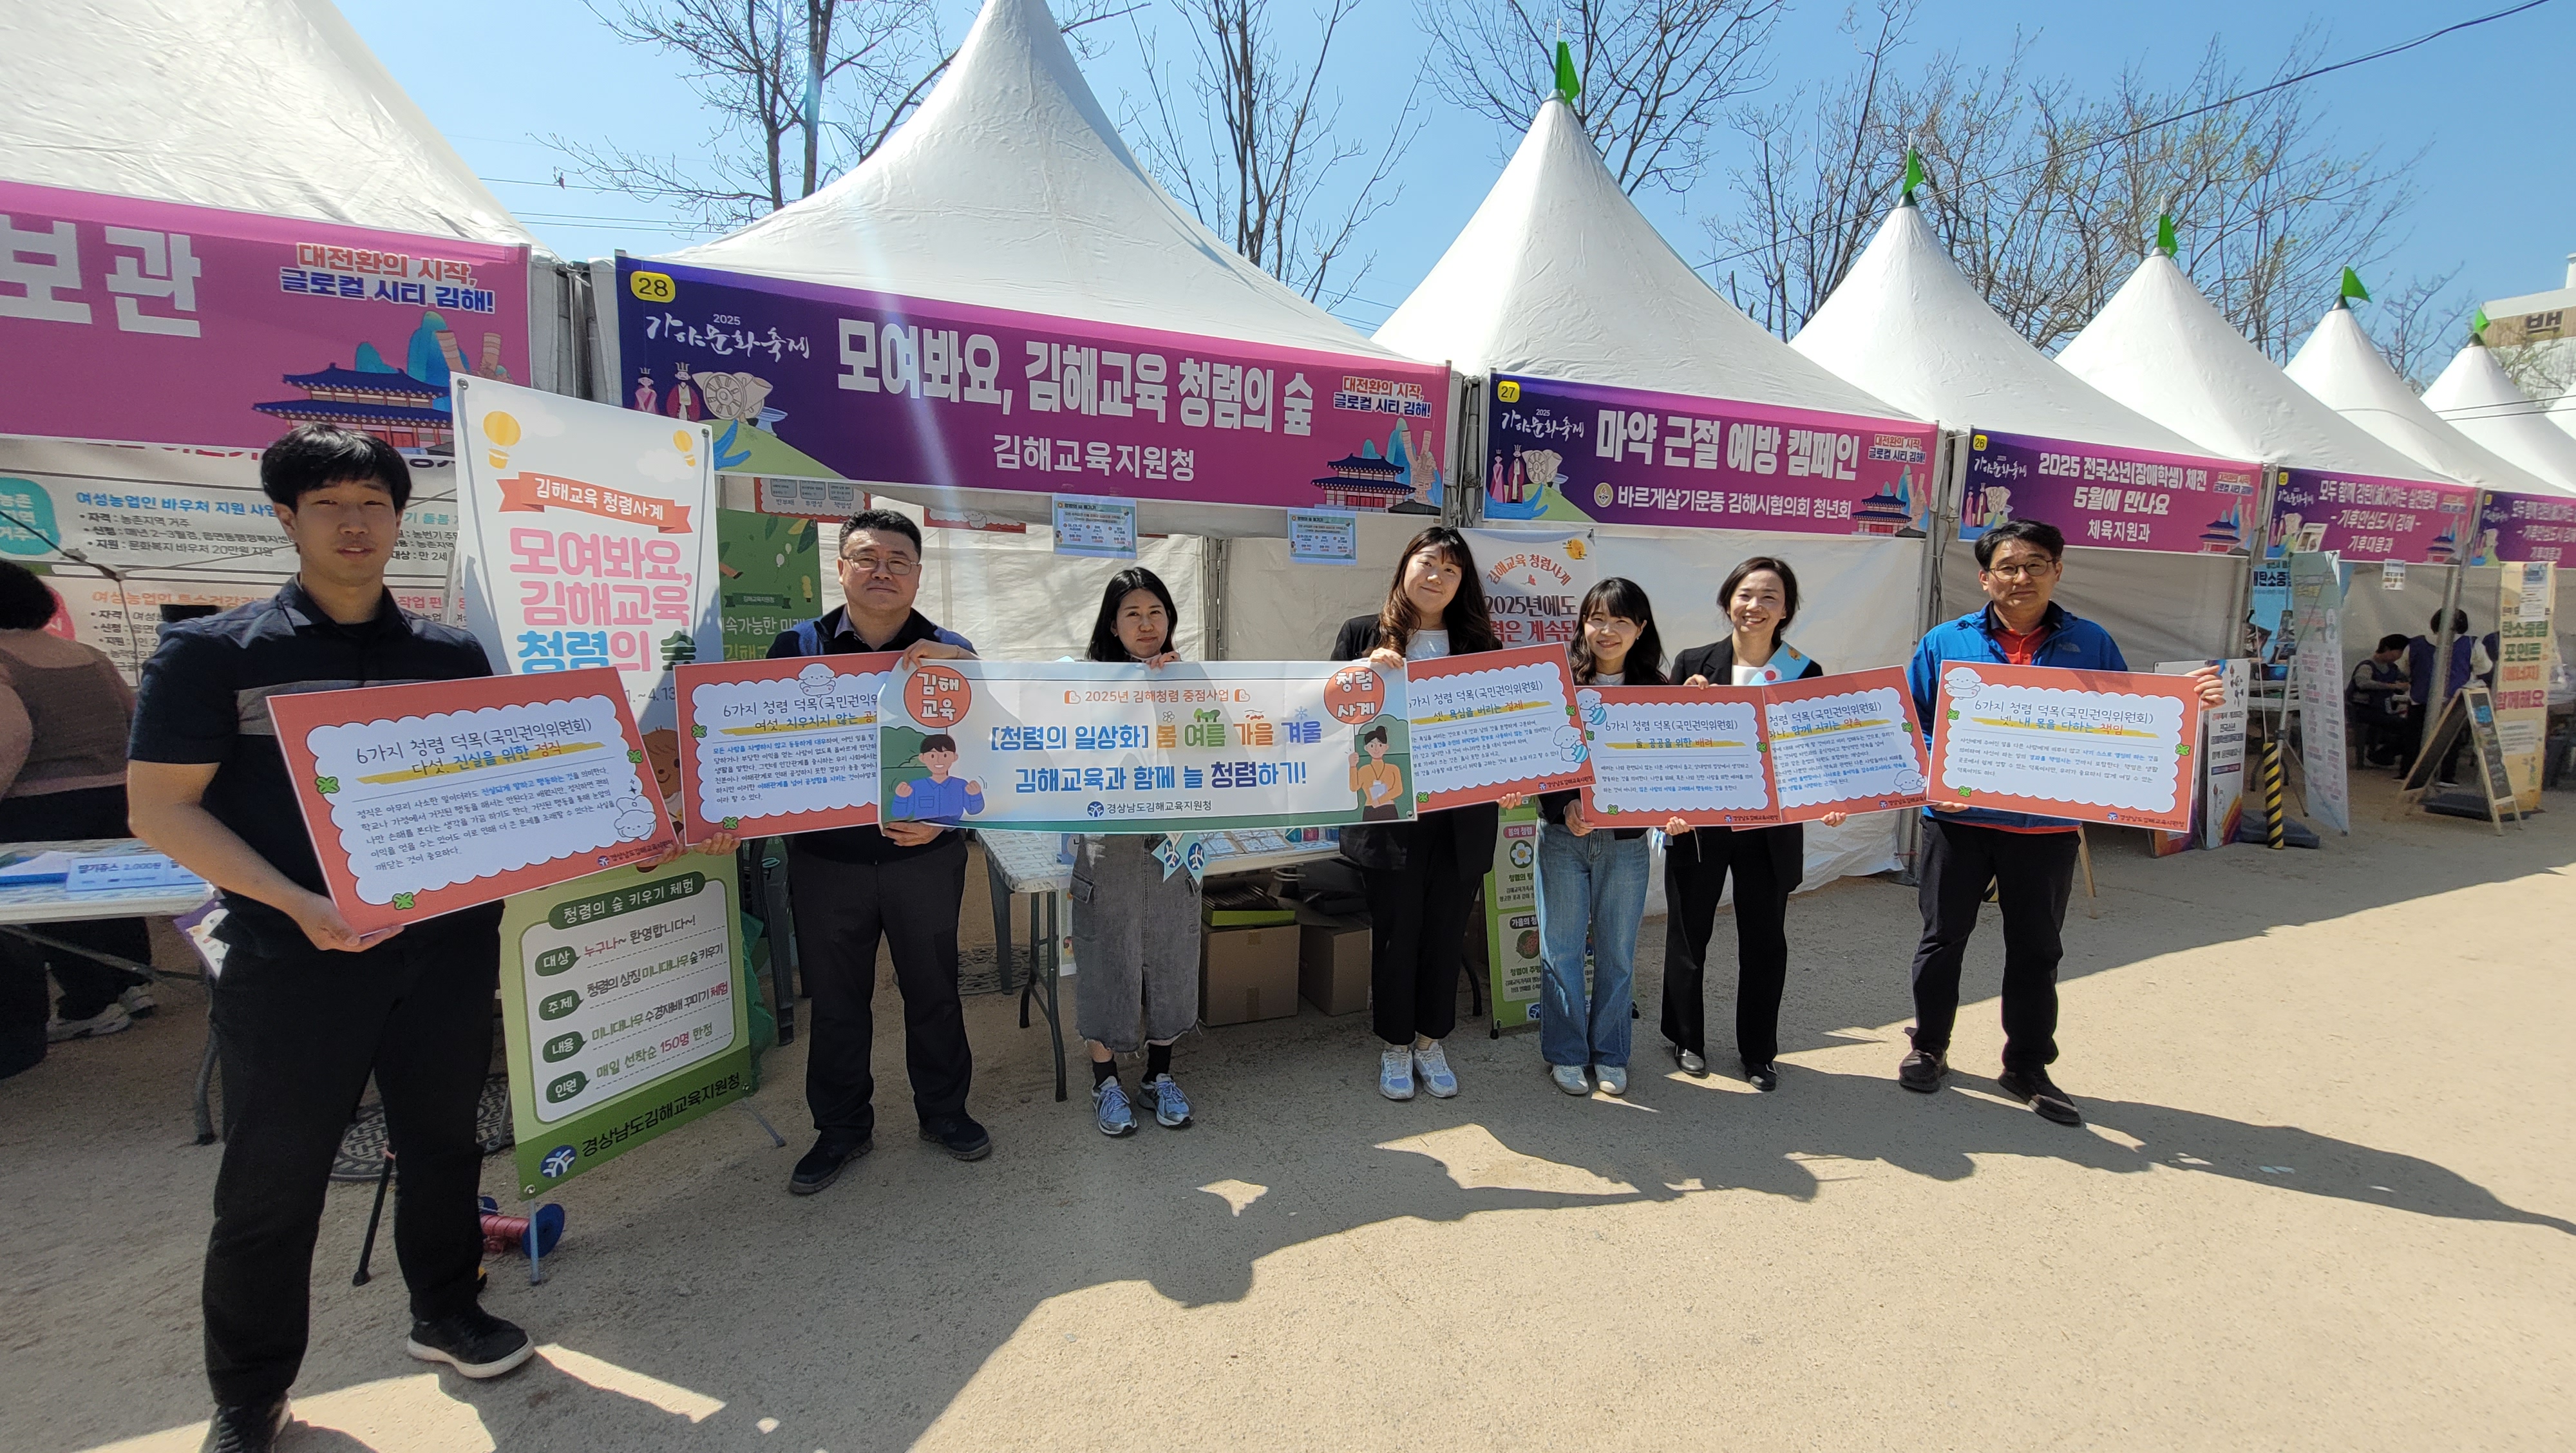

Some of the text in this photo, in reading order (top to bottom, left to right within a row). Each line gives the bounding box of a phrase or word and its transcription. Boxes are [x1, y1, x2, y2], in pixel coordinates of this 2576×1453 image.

[296, 243, 478, 287] 대전환의 시작,
[280, 267, 495, 313] 글로컬 시티 김해!
[639, 277, 668, 297] 28
[714, 314, 741, 326] 2025
[646, 312, 809, 363] 가야문화축제
[838, 318, 1313, 435] 모여봐요, 김해교육 청렴의 숲
[1343, 375, 1425, 401] 대전환의 시작,
[1501, 386, 1515, 399] 27
[1334, 392, 1431, 418] 글로컬 시티 김해!
[1502, 410, 1584, 441] 가야문화축제
[1596, 409, 1861, 480] 마약 근절 예방 캠페인
[1875, 434, 1904, 448] 대전환의
[1975, 437, 1985, 448] 26
[993, 435, 1195, 481] 김해교육지원청
[1869, 447, 1926, 463] 글로컬 시티 김해!
[2038, 452, 2080, 477] 2025
[2083, 457, 2183, 489] 전국소년(장애학생)
[2185, 468, 2208, 491] 체전
[535, 477, 663, 520] 김해교육 청렴사계
[2073, 486, 2170, 515] 5월에 만나요
[2318, 480, 2337, 502] 모두
[76, 491, 247, 516] 여성농업인 바우처 지원
[1618, 486, 1852, 520] 바르게살기운동 김해시협의회 청년회
[120, 515, 191, 528] 농촌지역 거주
[2087, 519, 2150, 542] 체육지원과
[2337, 509, 2396, 531] 기후안심도시
[412, 529, 442, 540] 농번기
[2348, 535, 2394, 553] 기후대응과
[176, 542, 251, 556] 바우처 20만원
[509, 527, 692, 586] 모여봐요,
[1486, 553, 1572, 587] 김해교육 청렴사계
[397, 596, 426, 609] 작업
[520, 580, 690, 627] 김해교육
[1484, 595, 1578, 618] 2025년에도
[516, 630, 697, 674] 청렴의 숲
[916, 672, 960, 696] 김해
[1335, 670, 1374, 692] 청렴
[1084, 689, 1229, 703] 2025년 김해청렴 중점사업
[1434, 692, 1453, 706] 청렴
[723, 699, 788, 718] 6가지 청렴
[920, 699, 957, 721] 교육
[1337, 701, 1376, 719] 사계
[1449, 699, 1524, 719] 욕심을 버리는 절제
[1975, 699, 2032, 716] 6가지 청렴
[755, 712, 859, 732] 여섯. 치우치지 않는
[1605, 720, 1651, 732] 6가지 청렴
[1769, 712, 1788, 726] 청렴
[1791, 716, 1862, 734] 함께 지키는 약속
[2019, 716, 2031, 728] 내
[2061, 721, 2094, 734] 다하는
[2099, 722, 2124, 736] 책임
[992, 720, 1322, 752] [청렴의 일상화] 봄 여름 가을 겨울
[1648, 737, 1714, 749] 공공을 위한 배려
[357, 736, 446, 764] 6가지 청렴
[412, 739, 562, 776] 다섯. 진실을 위한 정직
[1015, 761, 1307, 793] 김해교육과 함께 늘 청렴하기!
[357, 774, 565, 820] 정직은 아무리 사소한 일이더라도 진실되게 말하고 행동하는
[1107, 800, 1212, 814] 경상남도김해교육지원청
[361, 812, 427, 833] 학교나 가정에서
[564, 878, 694, 925] 청렴의 숲 키우기 체험
[1511, 916, 1531, 927] 가을의
[543, 950, 571, 967] 대상
[587, 977, 619, 998] 청렴의
[620, 968, 641, 988] 상징
[548, 995, 573, 1014] 주제
[592, 981, 728, 1041] 미니대나무 수경재배 꾸미기 체험
[552, 1038, 574, 1055] 내용
[596, 1022, 714, 1078] 매일 선착순 150명 한정
[555, 1078, 577, 1098] 인원
[582, 1072, 741, 1158] 경상남도김해교육지원청
